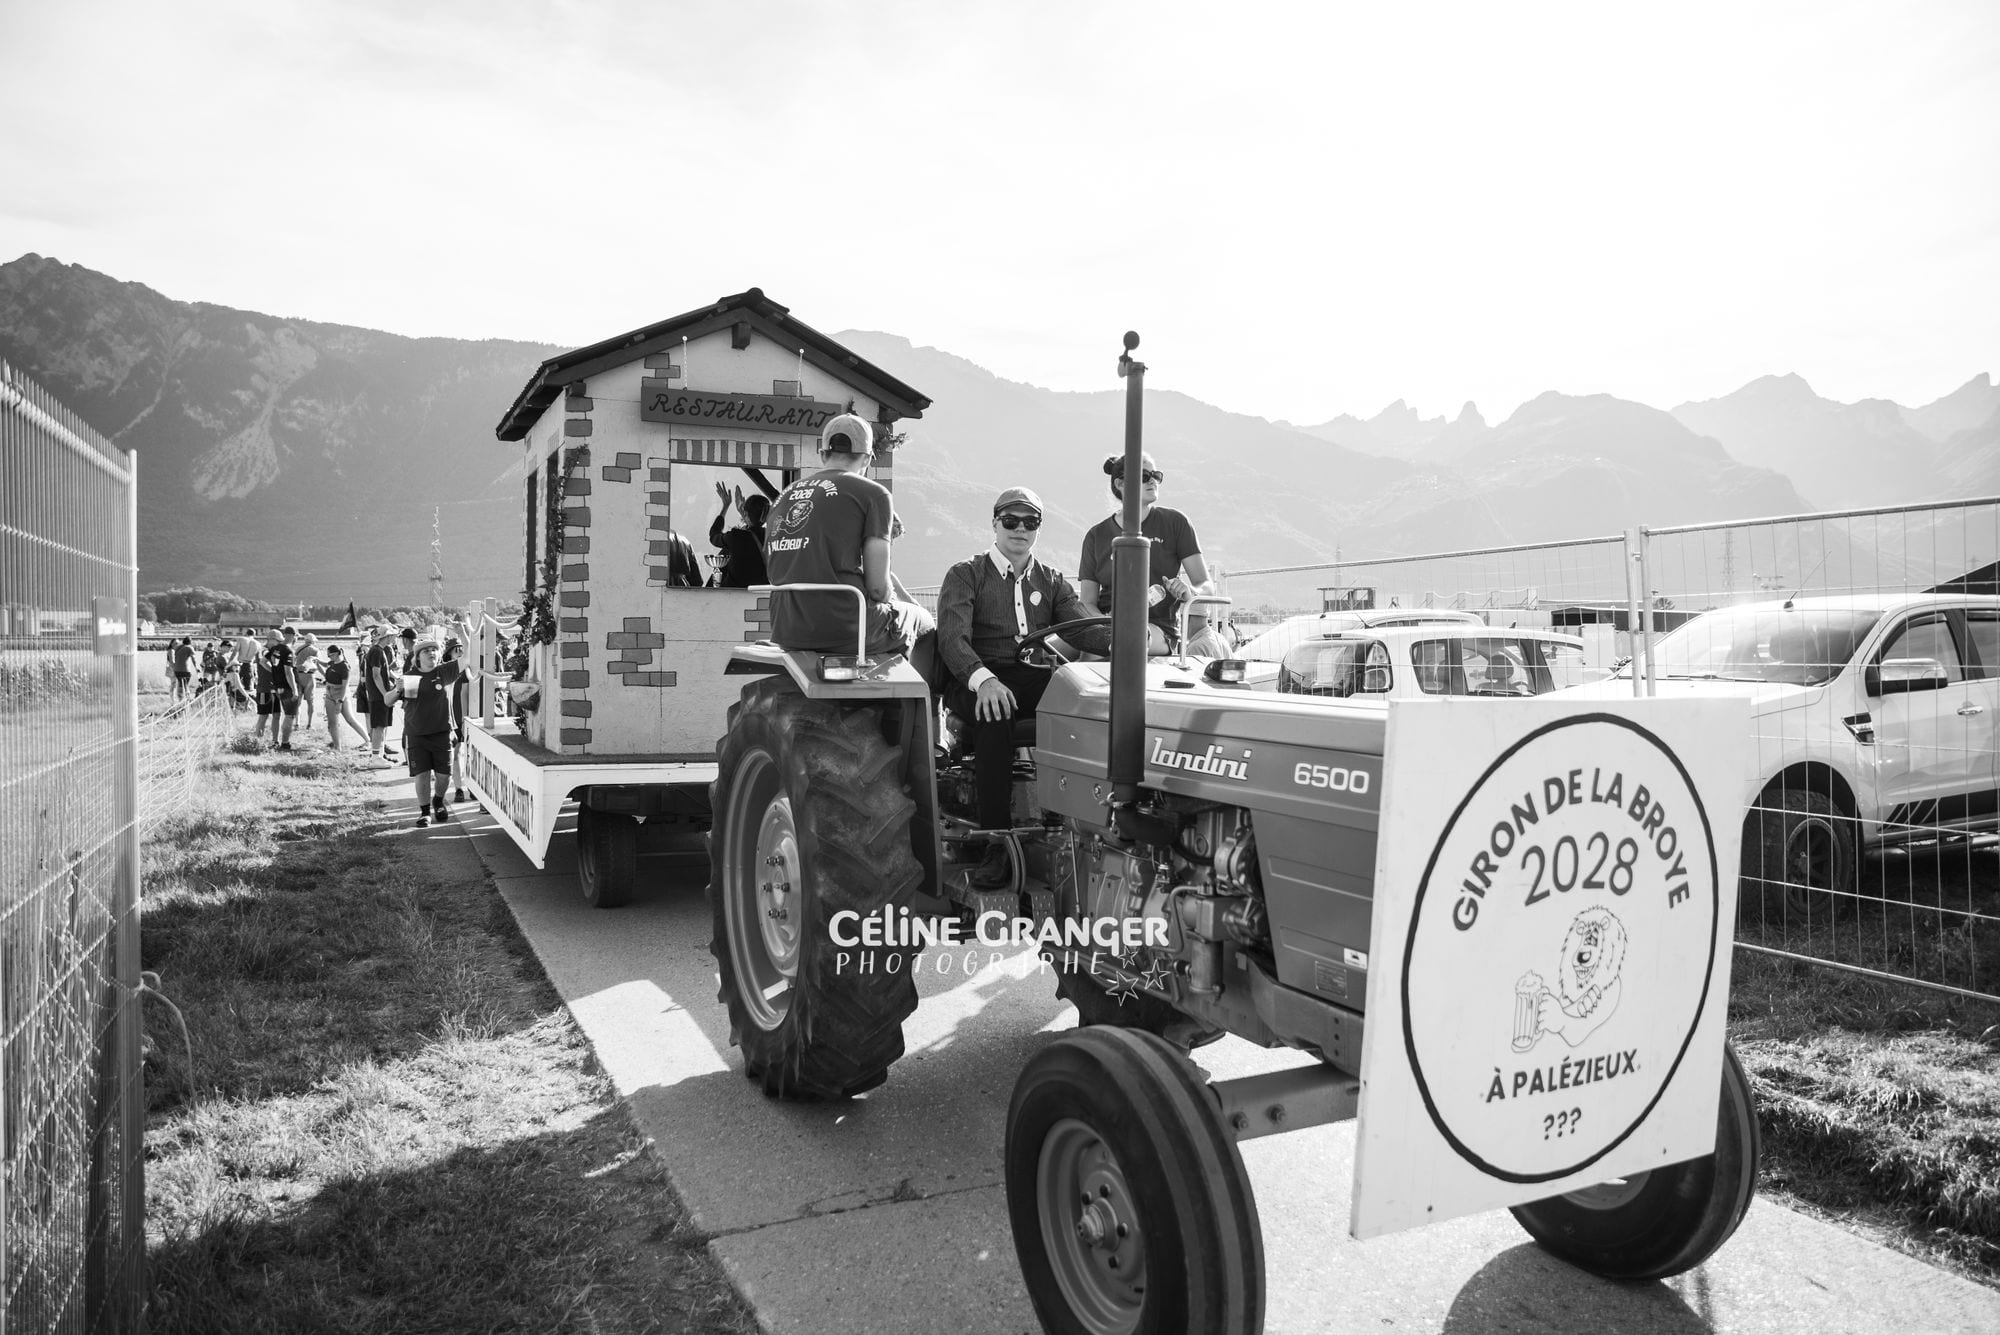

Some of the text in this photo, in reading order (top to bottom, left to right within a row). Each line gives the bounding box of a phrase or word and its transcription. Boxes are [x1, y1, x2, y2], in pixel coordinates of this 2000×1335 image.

[648, 392, 836, 429] RESTAURANT
[1294, 762, 1370, 794] 6500
[1453, 767, 1691, 932] GIRON DE LA BROYE
[1521, 831, 1639, 907] 2028
[1486, 1048, 1637, 1103] À PALÉZIEUX
[1543, 1106, 1582, 1141] ???
